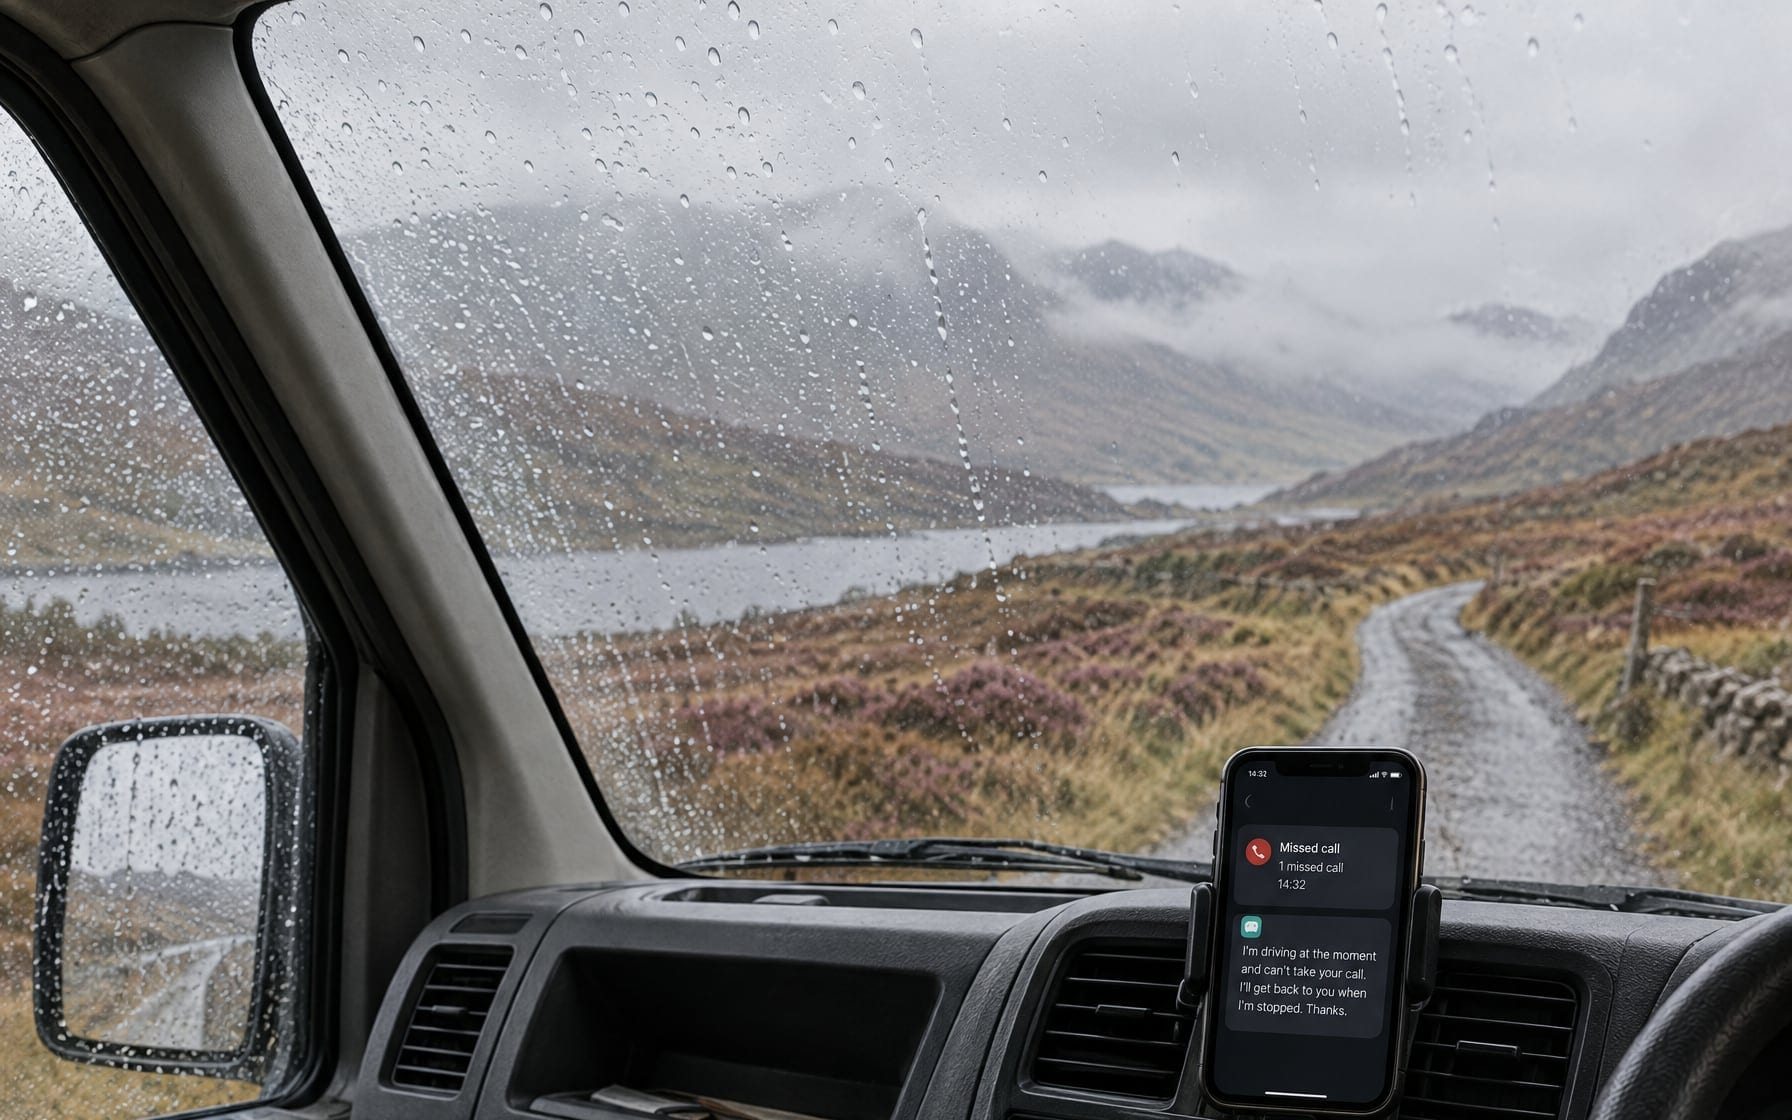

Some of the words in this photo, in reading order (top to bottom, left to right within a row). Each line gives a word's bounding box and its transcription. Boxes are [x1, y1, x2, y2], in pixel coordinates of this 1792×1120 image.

[1248, 770, 1267, 778] 14:32
[1280, 842, 1318, 854] Missed
[1321, 843, 1340, 854] call
[1279, 860, 1284, 871] 1
[1287, 861, 1323, 872] missed
[1326, 862, 1344, 873] call
[1278, 879, 1306, 890] 14:32
[1242, 945, 1258, 956] I'm
[1261, 946, 1297, 960] driving
[1299, 948, 1310, 959] at
[1313, 949, 1330, 960] the
[1333, 951, 1377, 962] moment
[1241, 964, 1261, 975] and
[1264, 965, 1290, 976] can't
[1293, 966, 1316, 977] take
[1319, 969, 1343, 980] your
[1345, 969, 1367, 980] call.
[1239, 982, 1251, 993] I'll
[1253, 983, 1271, 995] get
[1274, 983, 1299, 995] back
[1302, 986, 1313, 996] to
[1315, 988, 1335, 999] you
[1337, 988, 1367, 999] when
[1238, 1000, 1254, 1011] I'm
[1256, 1002, 1303, 1014] stopped.
[1306, 1003, 1348, 1016] Thanks.
